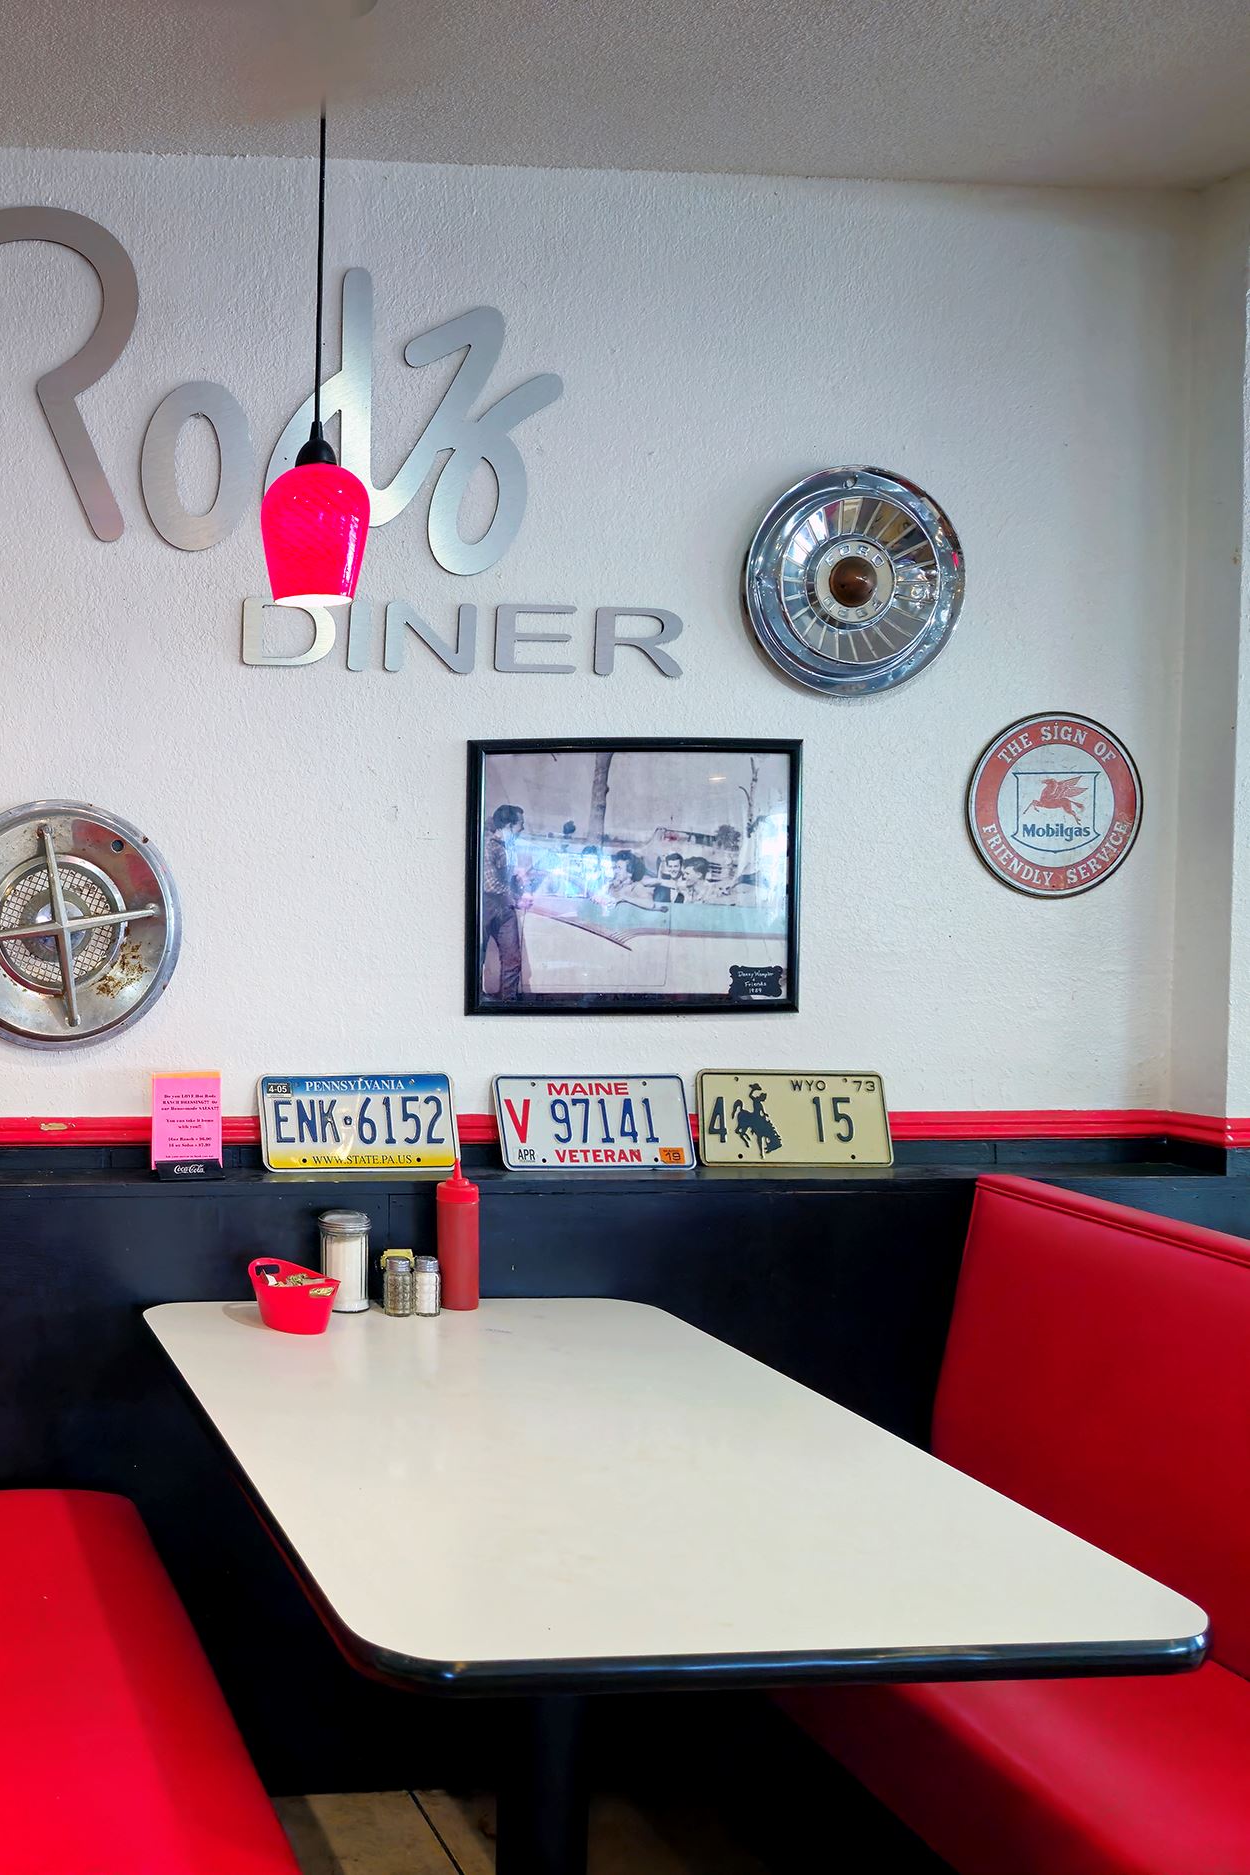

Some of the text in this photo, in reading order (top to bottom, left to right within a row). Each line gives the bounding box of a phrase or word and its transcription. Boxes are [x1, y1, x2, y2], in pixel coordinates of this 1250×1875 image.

[826, 545, 884, 568] FORD
[242, 597, 684, 678] DINER
[998, 724, 1116, 764] THE SIGN OF
[1022, 824, 1090, 841] Mobilgas
[982, 821, 1128, 886] FRIENDLY SERVICE
[305, 1079, 405, 1092] PENNSYLVANIA
[547, 1082, 629, 1096] MAINE
[790, 1080, 876, 1092] WYO 73
[504, 1098, 659, 1144] V 97141
[708, 1096, 855, 1143] 4 15
[312, 1155, 412, 1165] WWW.STATE.PA.US
[518, 1149, 681, 1163] APR VETERAN 19
[174, 1164, 205, 1174] Coca-Cola
